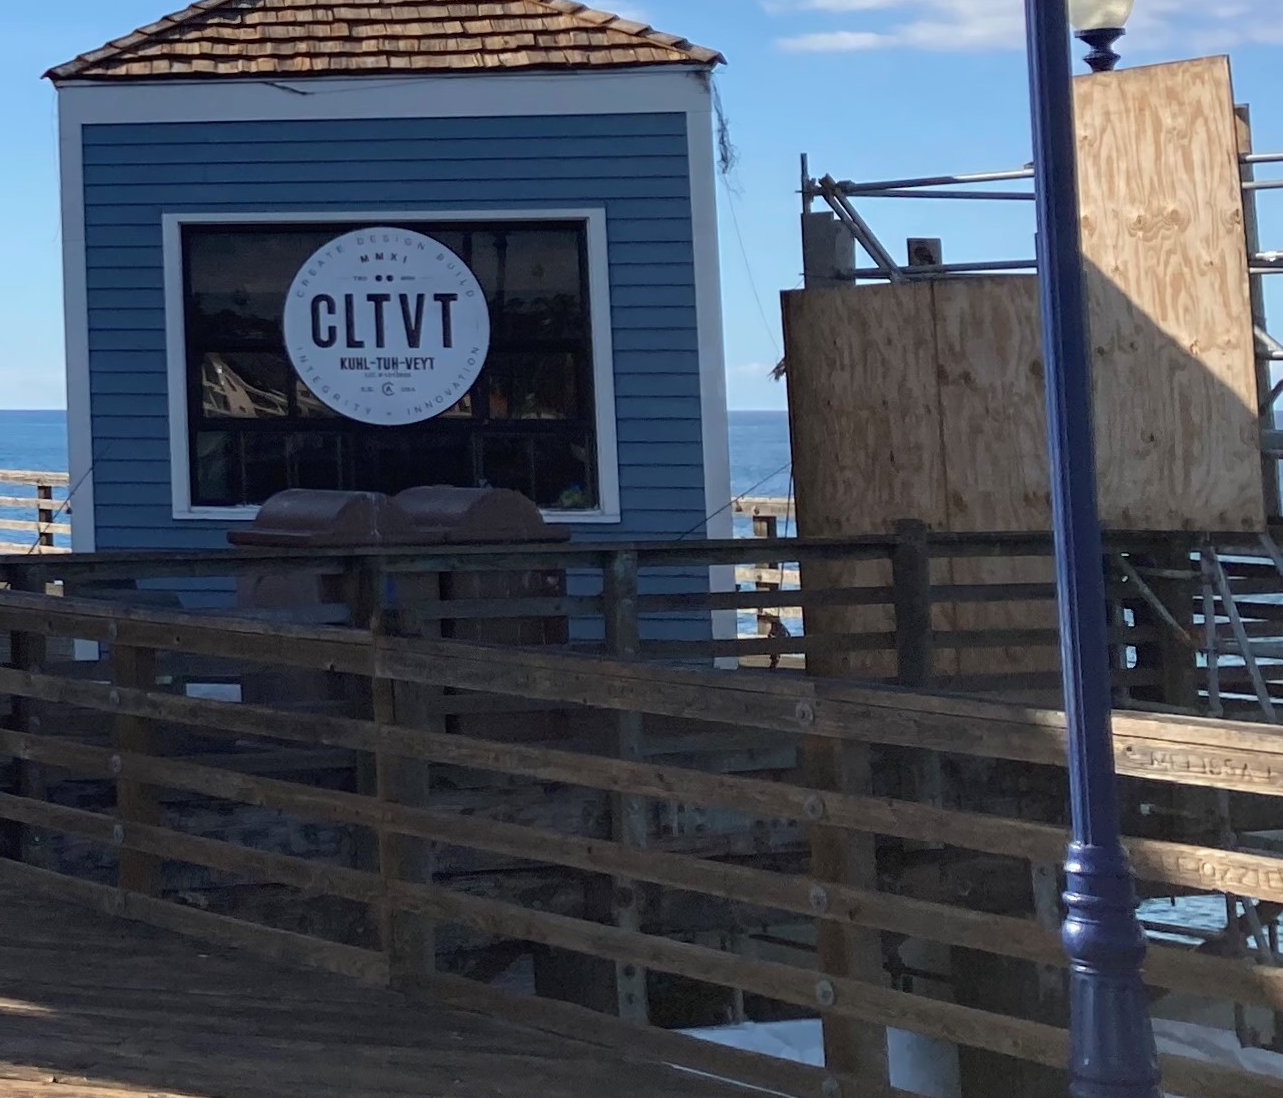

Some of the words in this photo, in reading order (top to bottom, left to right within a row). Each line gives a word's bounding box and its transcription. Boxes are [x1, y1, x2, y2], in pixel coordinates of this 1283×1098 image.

[296, 244, 345, 299] CREATE
[356, 233, 426, 252] DESIGN
[435, 252, 476, 298] BUILD
[359, 252, 408, 264] MMXI
[310, 292, 459, 349] CLTVT
[296, 345, 372, 415] INTEGRITY
[406, 345, 480, 416] INNOVATION
[339, 356, 436, 371] KUHL-TUH-VEYT
